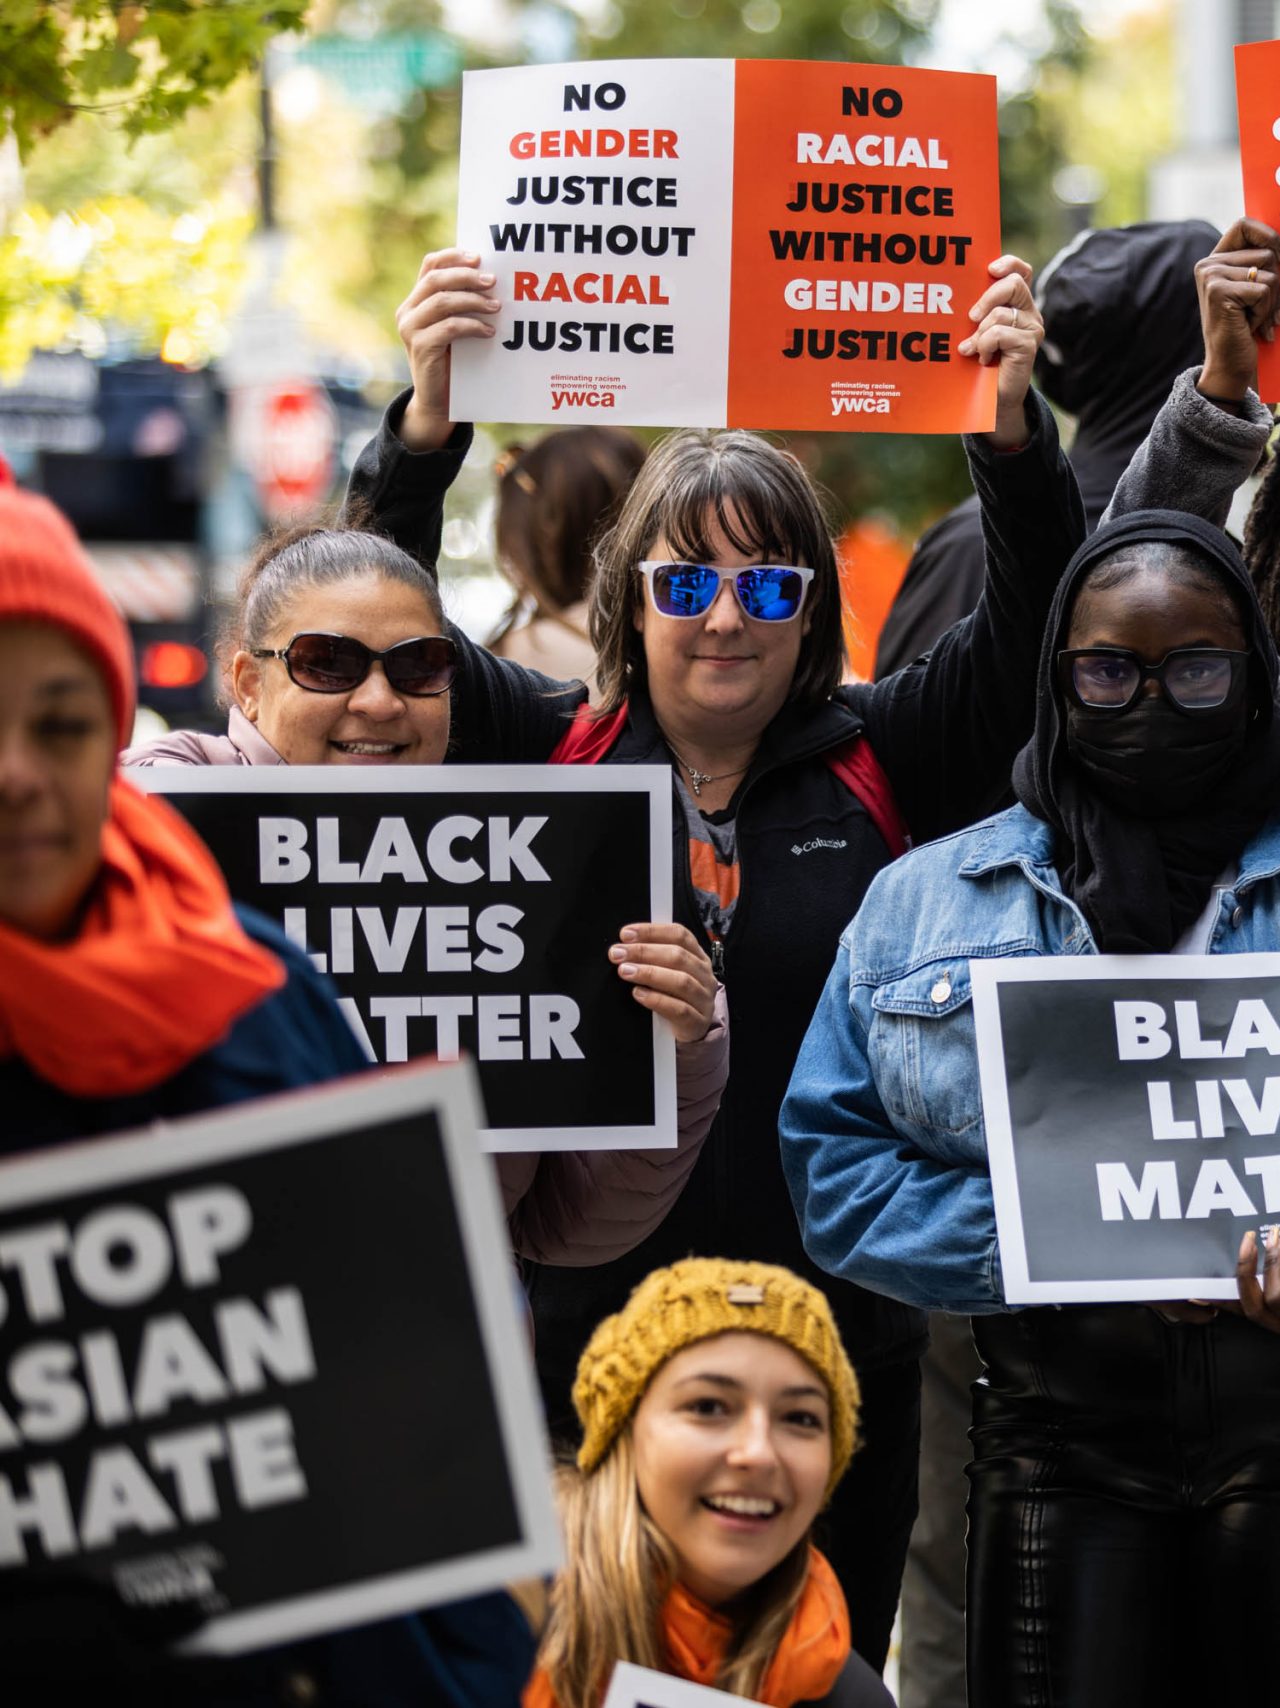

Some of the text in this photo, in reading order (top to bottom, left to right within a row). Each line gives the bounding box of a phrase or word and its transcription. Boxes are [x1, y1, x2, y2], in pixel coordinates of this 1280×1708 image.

[563, 82, 626, 112] NO
[842, 86, 903, 118] NO
[509, 129, 680, 160] GENDER
[797, 133, 948, 169] RACIAL
[506, 176, 677, 207] JUSTICE
[786, 182, 954, 217] JUSTICE
[489, 223, 696, 257] WITHOUT
[769, 230, 972, 266] WITHOUT
[514, 271, 670, 305] RACIAL
[784, 279, 953, 314] GENDER
[502, 320, 674, 354] JUSTICE
[782, 329, 950, 362] JUSTICE
[550, 374, 593, 382] eliminating
[551, 391, 615, 410] ywca
[831, 397, 890, 416] ywca
[258, 816, 551, 884] BLACK
[284, 904, 525, 974] LIVES
[336, 994, 586, 1063] TTER
[0, 1183, 253, 1330] TOP
[0, 1285, 316, 1448] SIAN
